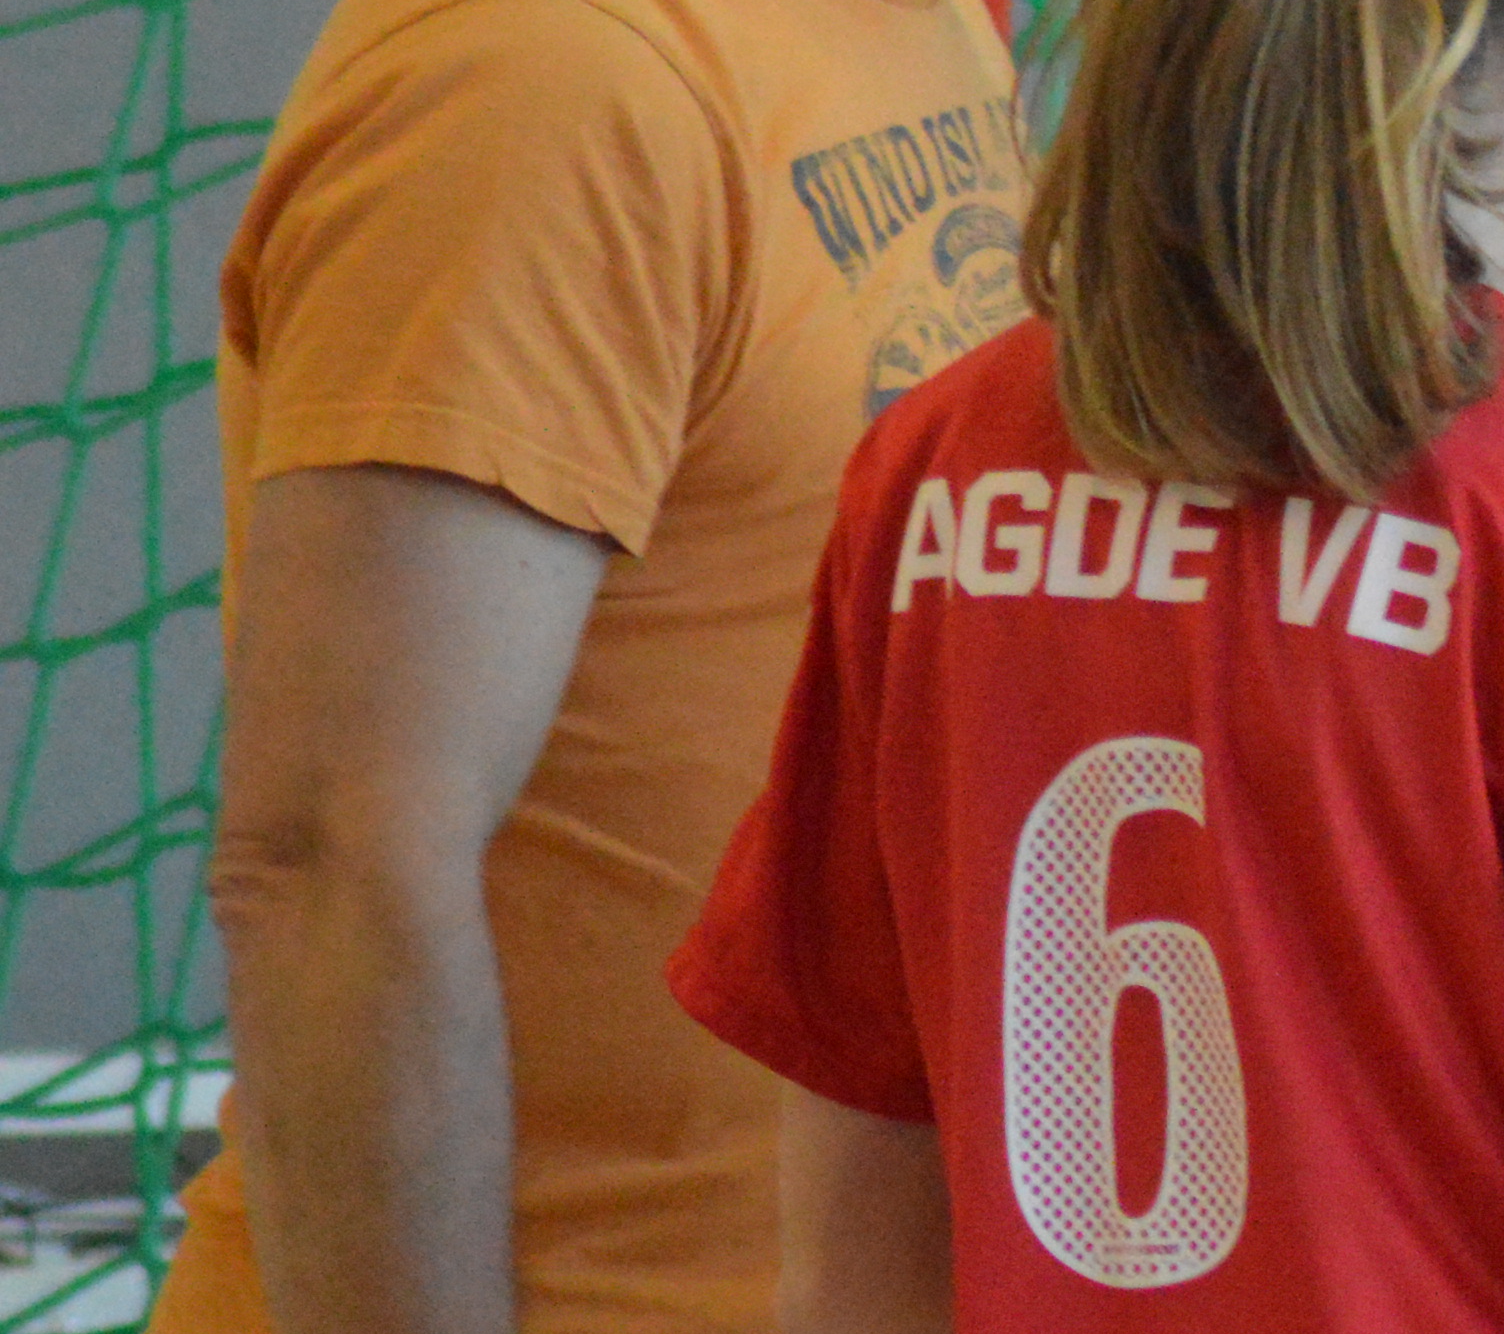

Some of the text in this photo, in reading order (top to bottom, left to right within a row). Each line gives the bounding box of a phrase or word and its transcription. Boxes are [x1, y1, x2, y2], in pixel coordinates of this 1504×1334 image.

[891, 470, 1461, 656] AGDE VB
[1002, 734, 1249, 1289] 6
